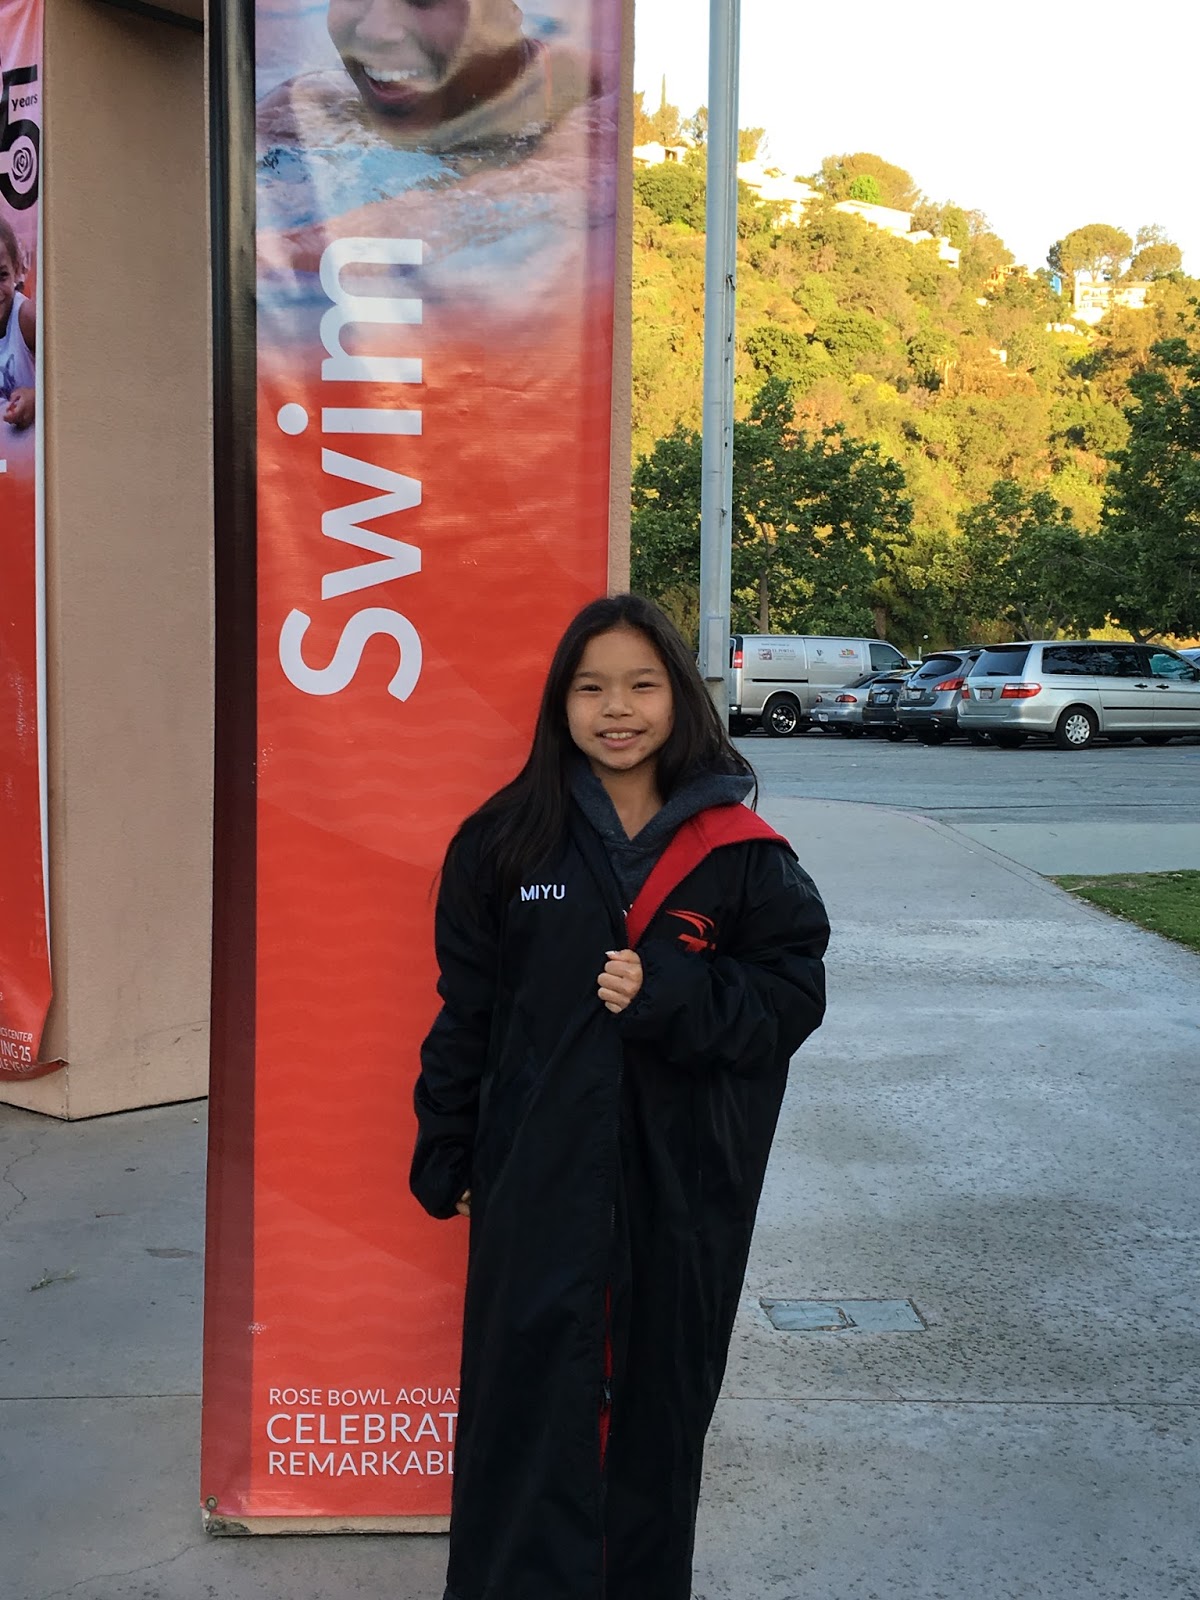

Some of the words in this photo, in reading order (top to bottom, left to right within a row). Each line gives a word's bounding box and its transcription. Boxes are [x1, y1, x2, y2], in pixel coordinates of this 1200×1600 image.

[11, 94, 38, 111] years
[277, 236, 423, 703] Swim
[520, 884, 566, 901] MIYU
[8, 1029, 33, 1043] CENTER
[18, 1045, 32, 1063] 25
[269, 1388, 322, 1406] ROSE
[328, 1388, 391, 1406] BOWL
[266, 1412, 459, 1444] CELEBRAT
